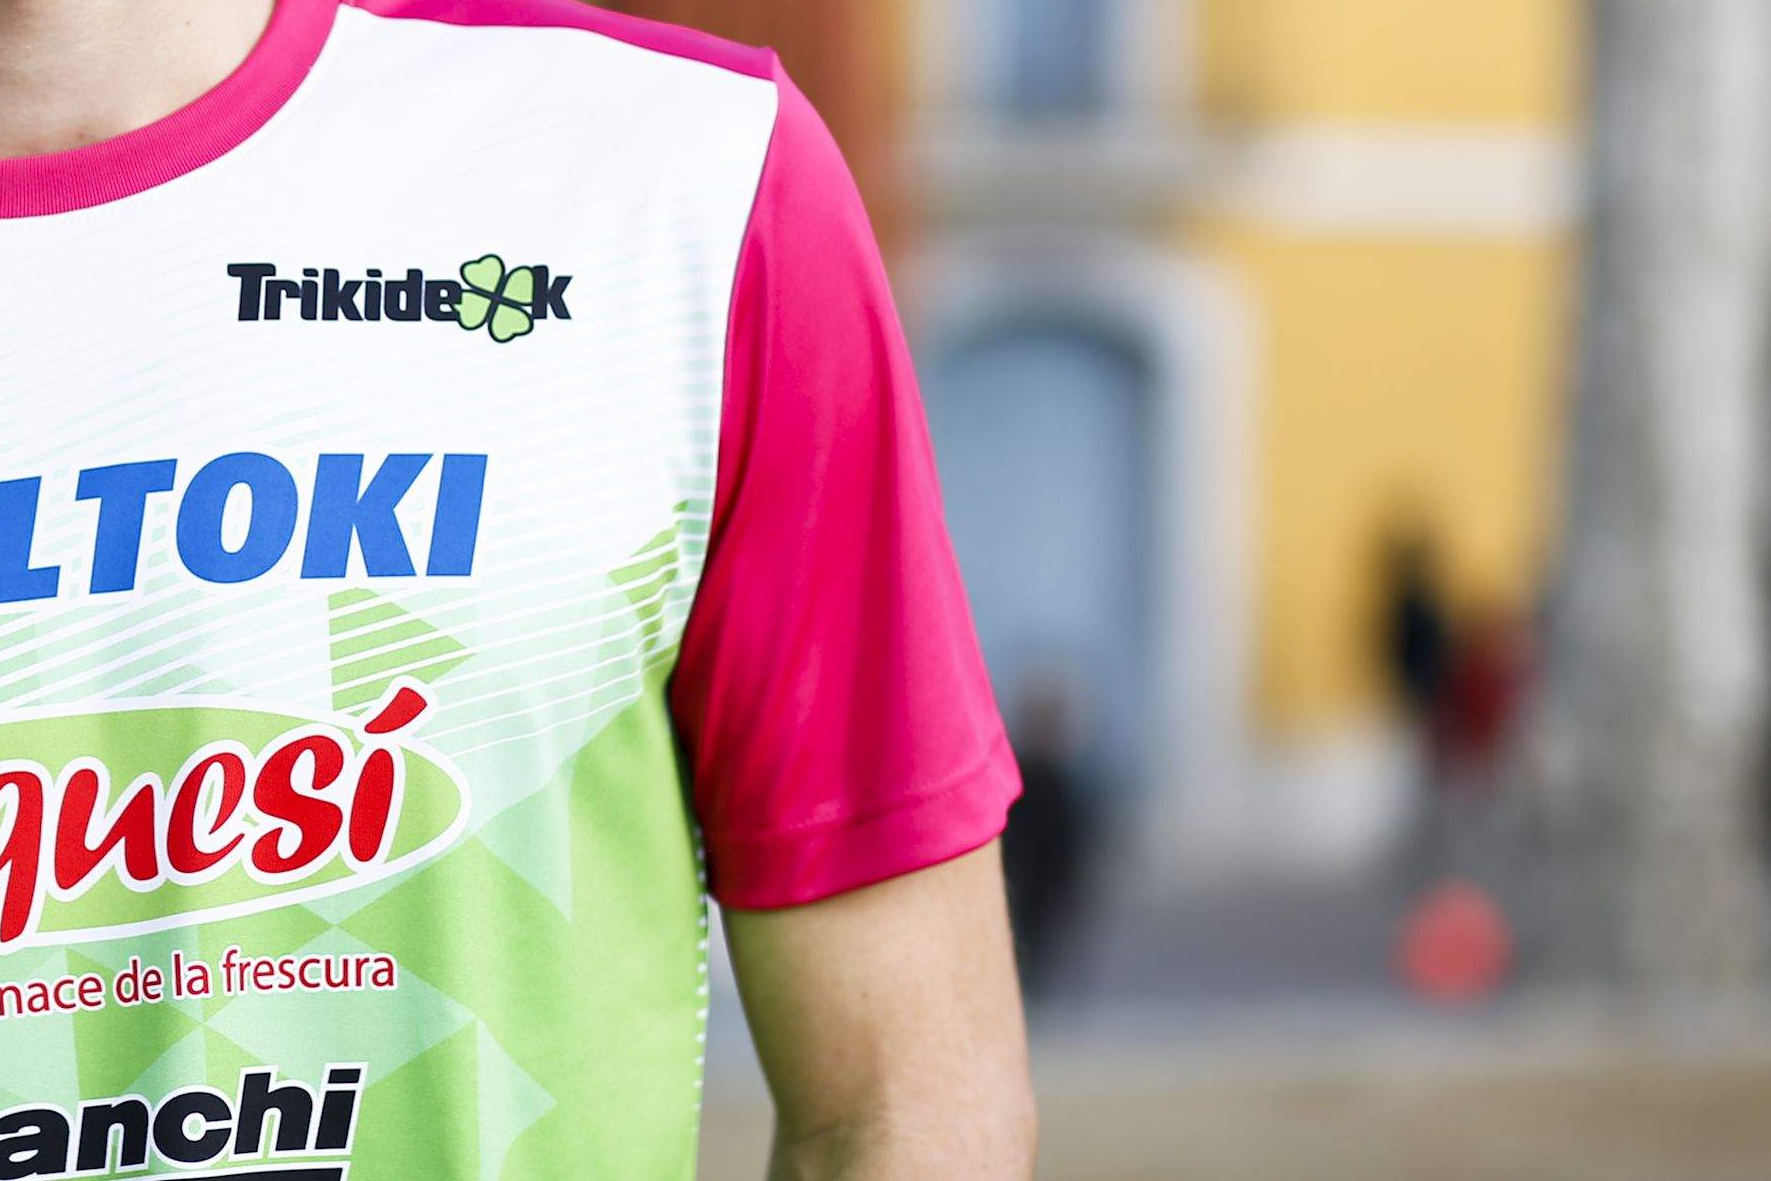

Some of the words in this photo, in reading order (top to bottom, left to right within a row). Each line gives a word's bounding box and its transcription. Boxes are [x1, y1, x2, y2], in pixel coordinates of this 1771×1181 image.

[116, 959, 162, 1003] de
[174, 953, 210, 996] la
[222, 949, 395, 992] frescura
